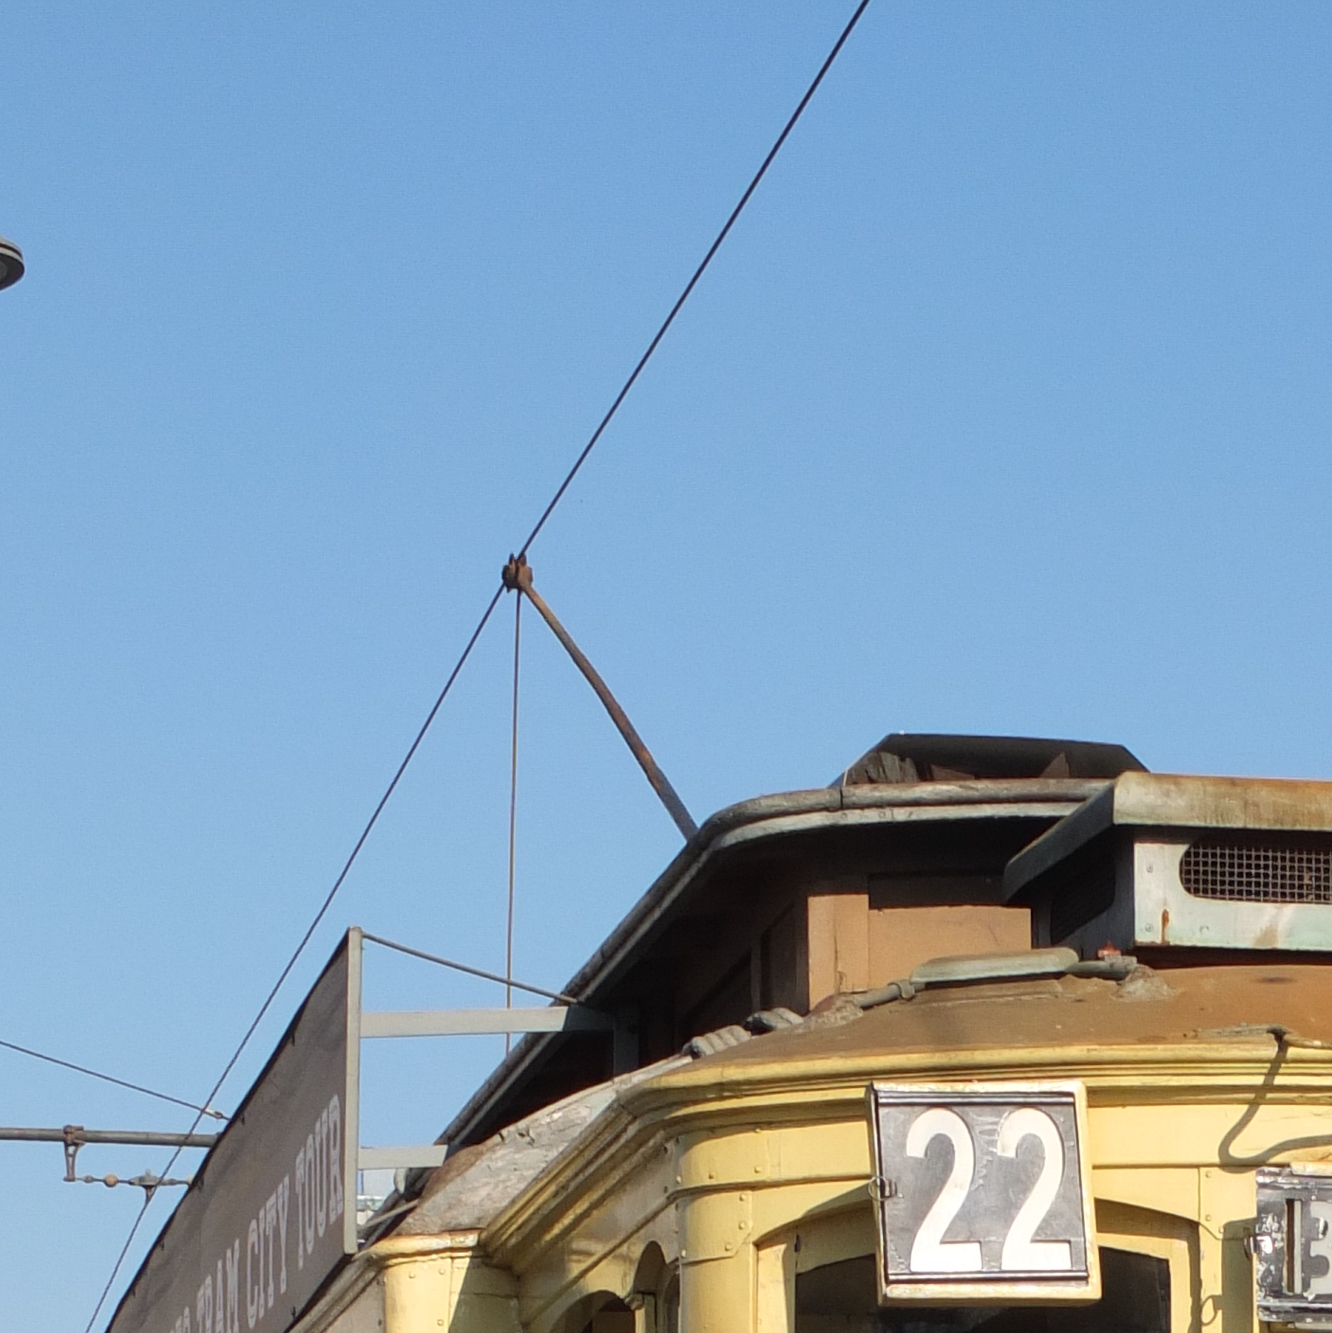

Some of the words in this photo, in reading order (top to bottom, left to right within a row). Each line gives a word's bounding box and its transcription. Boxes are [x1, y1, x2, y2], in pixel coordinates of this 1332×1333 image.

[247, 1173, 290, 1330] CITY
[295, 1094, 344, 1271] TOUR
[905, 1107, 1073, 1272] 22
